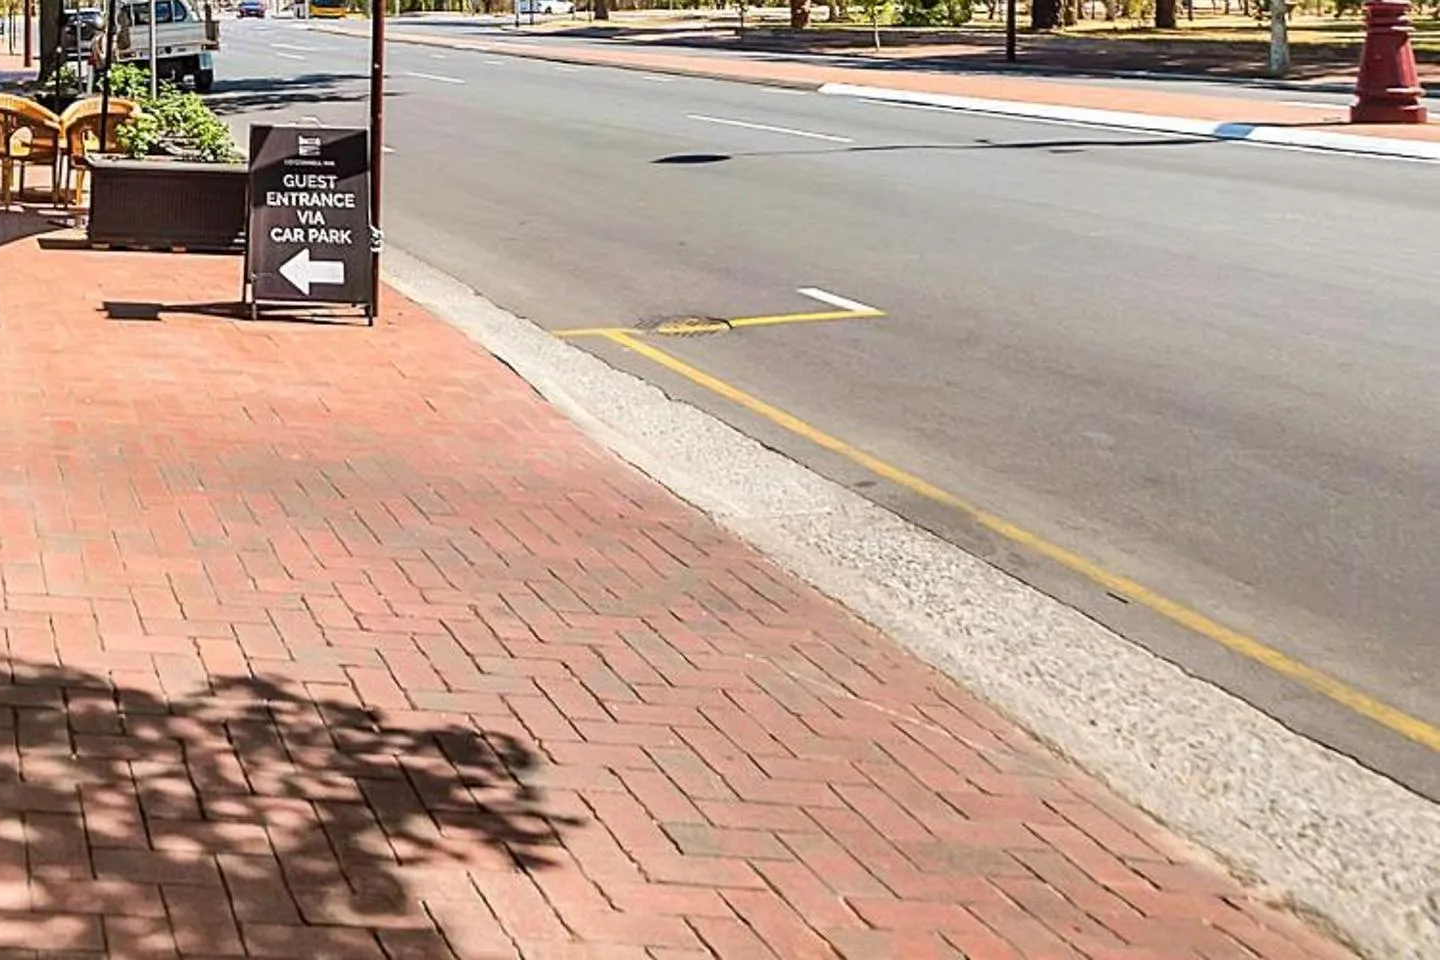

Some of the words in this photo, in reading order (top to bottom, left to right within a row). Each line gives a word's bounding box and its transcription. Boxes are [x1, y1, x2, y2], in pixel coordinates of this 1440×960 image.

[283, 174, 338, 190] GUEST
[266, 192, 356, 208] ENTRANCE
[296, 209, 326, 226] VIA
[270, 227, 306, 242] CAR
[309, 228, 353, 244] PARK
